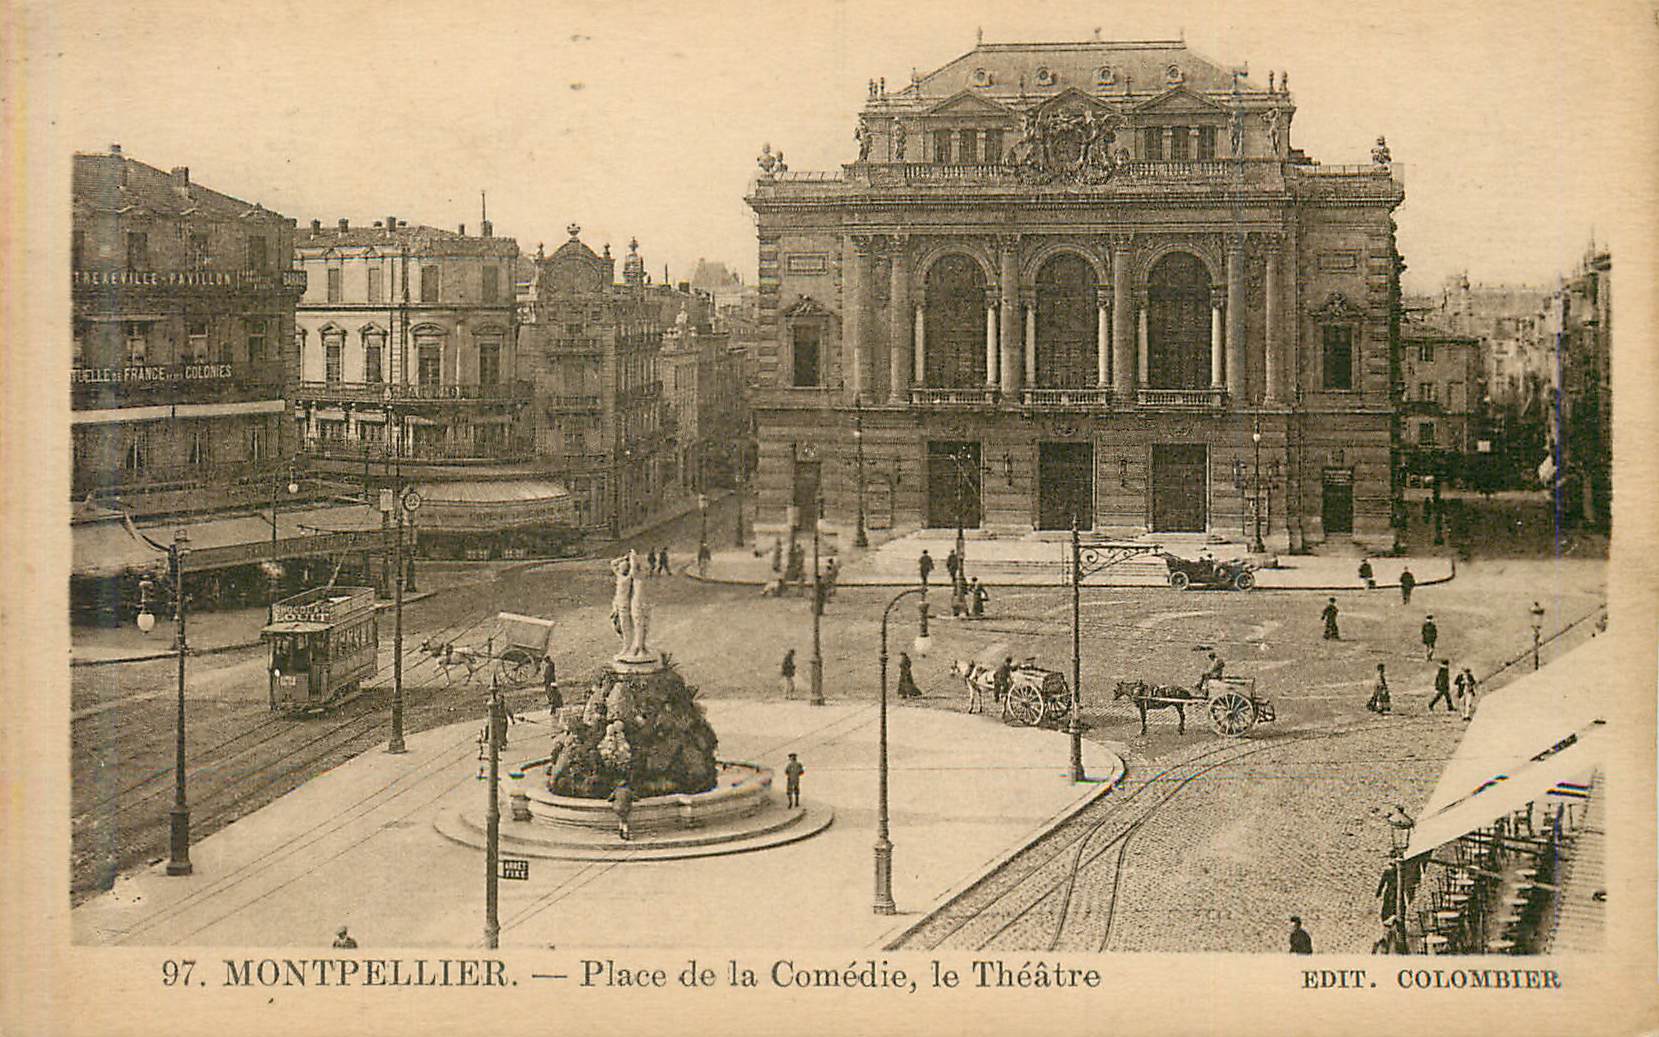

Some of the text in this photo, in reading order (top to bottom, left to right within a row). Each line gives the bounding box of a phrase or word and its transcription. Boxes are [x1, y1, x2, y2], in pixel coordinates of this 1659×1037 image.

[124, 367, 165, 382] FRANCE
[185, 364, 232, 380] COLONIES
[274, 613, 330, 622] LOUIT
